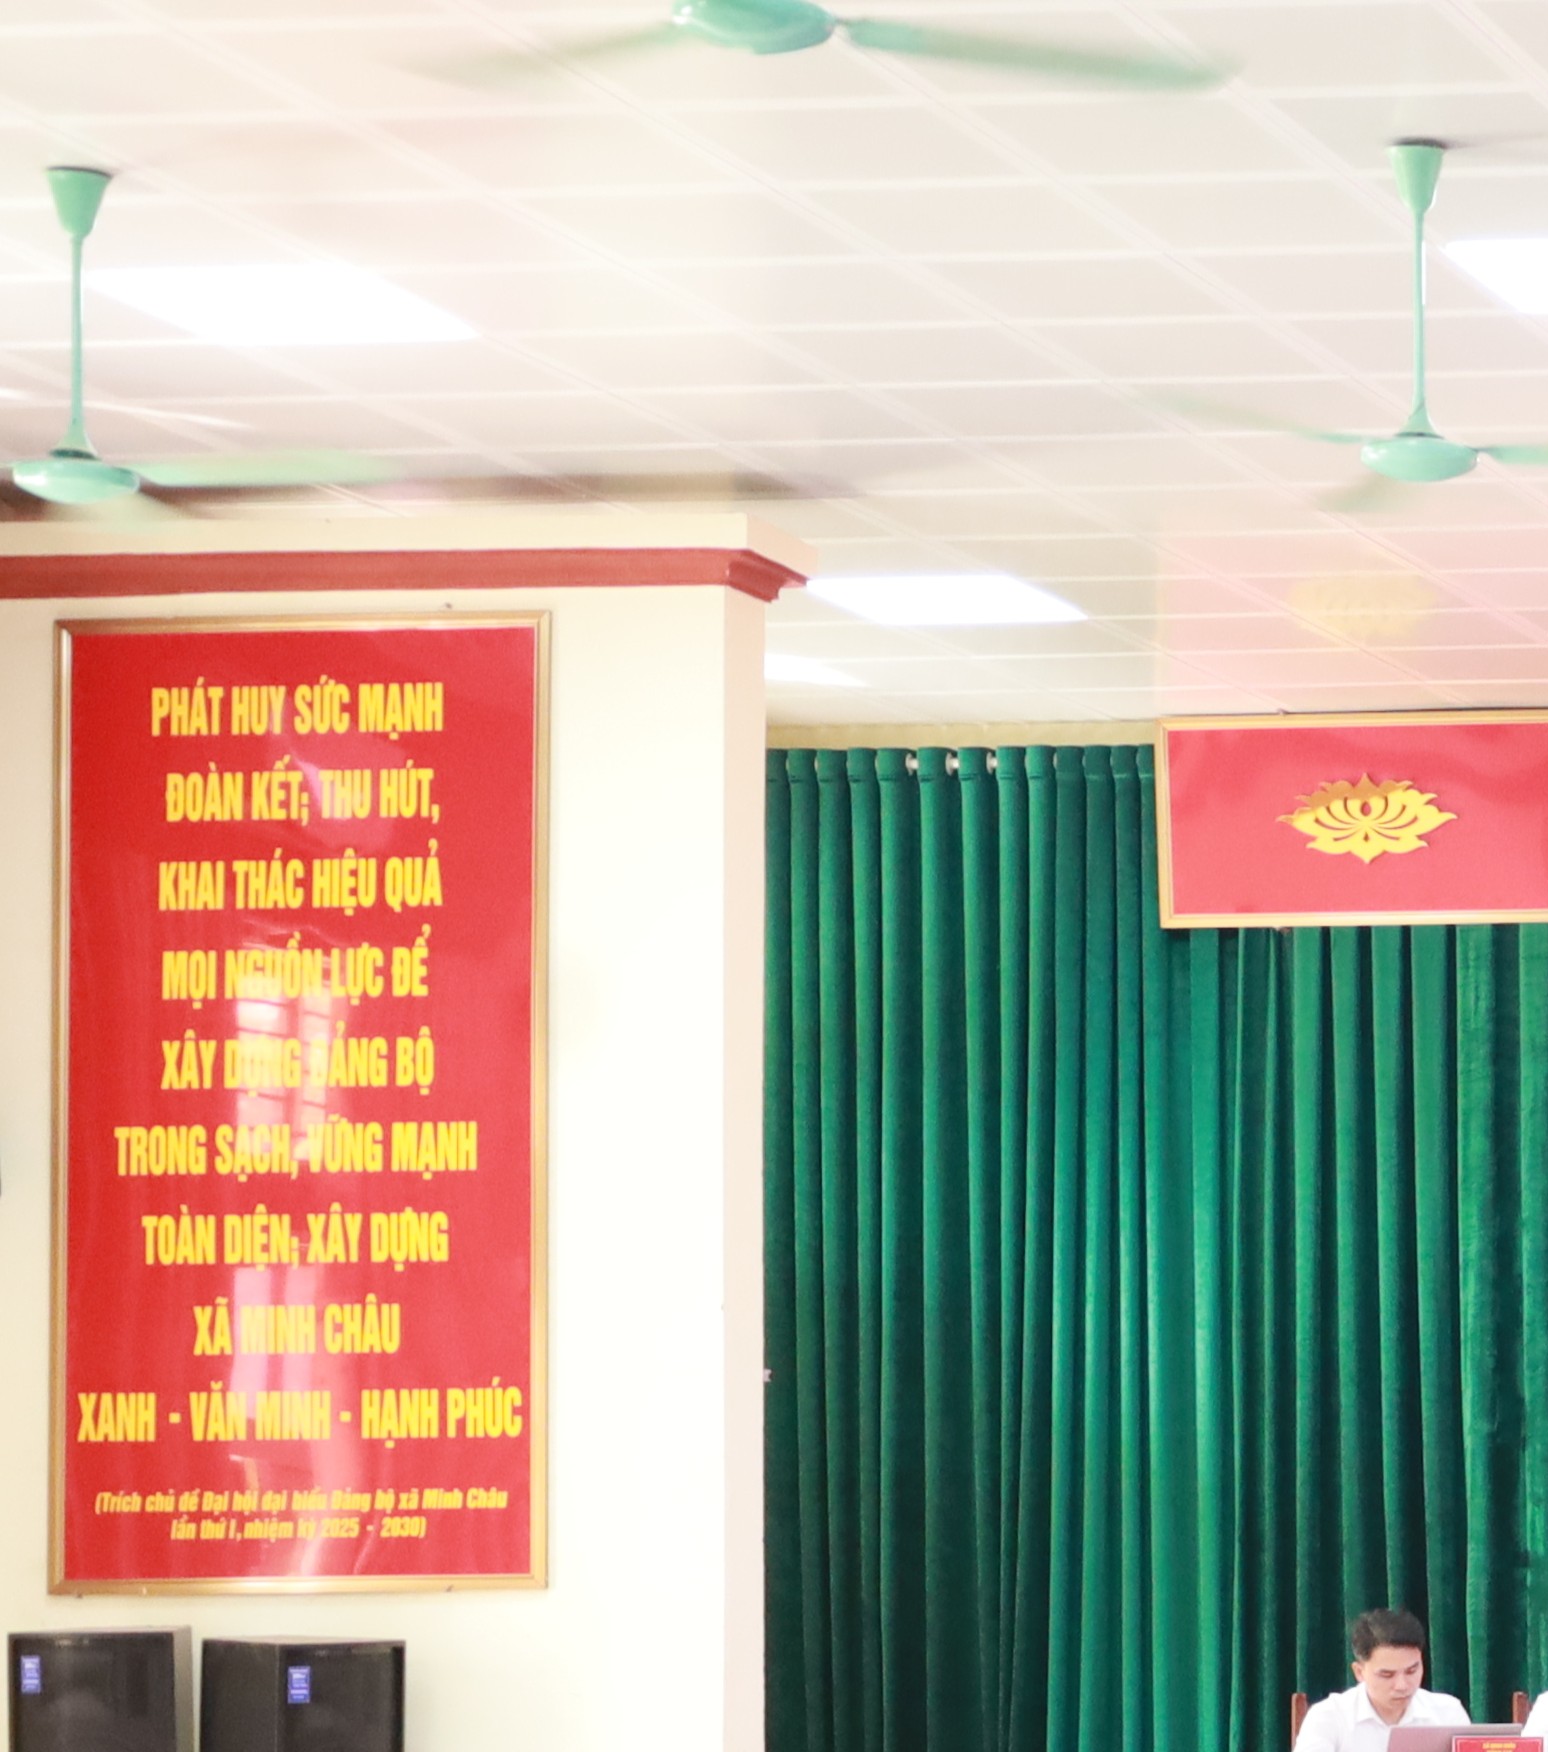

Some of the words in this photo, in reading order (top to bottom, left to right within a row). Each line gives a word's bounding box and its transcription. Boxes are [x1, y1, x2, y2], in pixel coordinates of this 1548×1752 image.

[151, 678, 225, 736] PHÁT
[230, 686, 286, 735] HUY
[357, 683, 444, 739] MẠNH
[165, 764, 245, 822] ĐOÀN
[158, 861, 226, 910] KHAI
[231, 849, 306, 909] THÁC
[162, 950, 218, 1009] MỌI
[160, 1030, 218, 1089] XÂY
[395, 1026, 435, 1095] BỘ
[113, 1125, 208, 1176] TRONG
[390, 1121, 478, 1180] MẠNH
[141, 1205, 217, 1265] TOÀN
[306, 1202, 363, 1263] XÂY
[193, 1297, 233, 1356] XÃ
[323, 1294, 401, 1354] CHÂU
[77, 1392, 158, 1442] XANH
[361, 1388, 440, 1448] HẠNH
[446, 1377, 524, 1438] PHÚC
